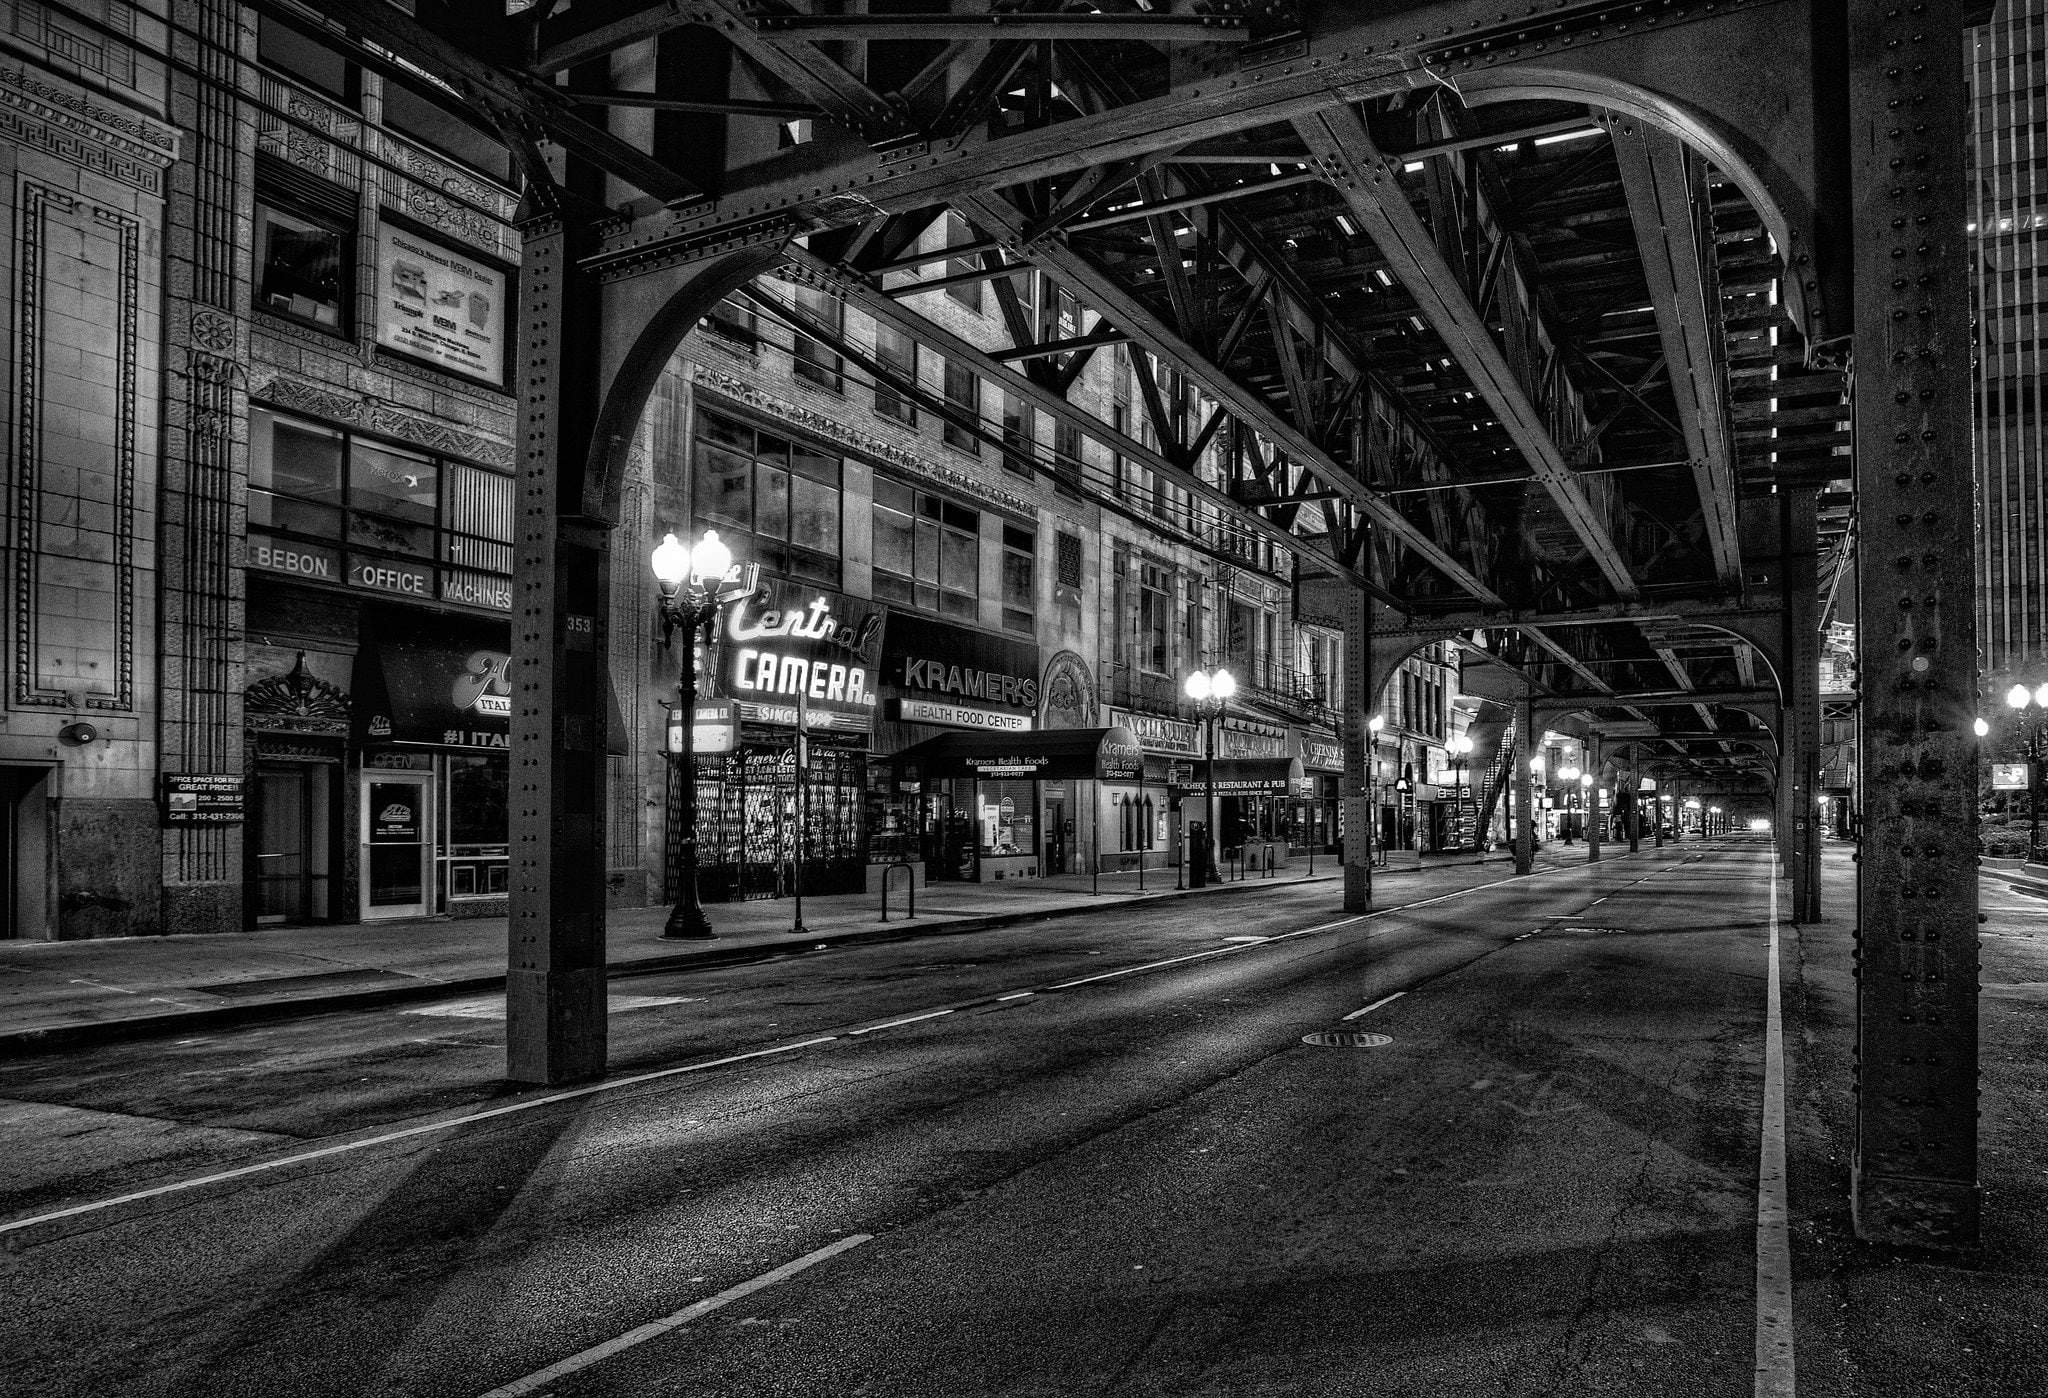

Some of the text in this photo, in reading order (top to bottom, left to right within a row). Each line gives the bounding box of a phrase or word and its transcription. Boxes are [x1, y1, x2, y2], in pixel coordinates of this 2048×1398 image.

[393, 236, 424, 255] Chicago's
[426, 250, 449, 267] Newest
[394, 300, 423, 318] Triumph
[370, 466, 401, 483] xerox
[257, 547, 328, 577] BEBON
[363, 565, 424, 594] OFFICE
[443, 581, 513, 609] MACHINES
[567, 616, 591, 633] 353
[730, 581, 883, 664] Central
[737, 649, 866, 704] CAMERA
[904, 656, 1038, 707] KRAMER'S
[760, 706, 798, 723] SINCE
[913, 704, 952, 721] HEALTH
[956, 710, 984, 725] FOOD
[1101, 738, 1139, 756] Kramers
[374, 754, 412, 769] OPEN
[966, 756, 1049, 766] Kramers Health Foods
[1101, 757, 1139, 770] Health Foods
[178, 783, 208, 791] GREAT
[1177, 781, 1216, 791] EXCHEQR
[1218, 780, 1262, 790] RESTAURANT
[1271, 780, 1286, 788] PUB
